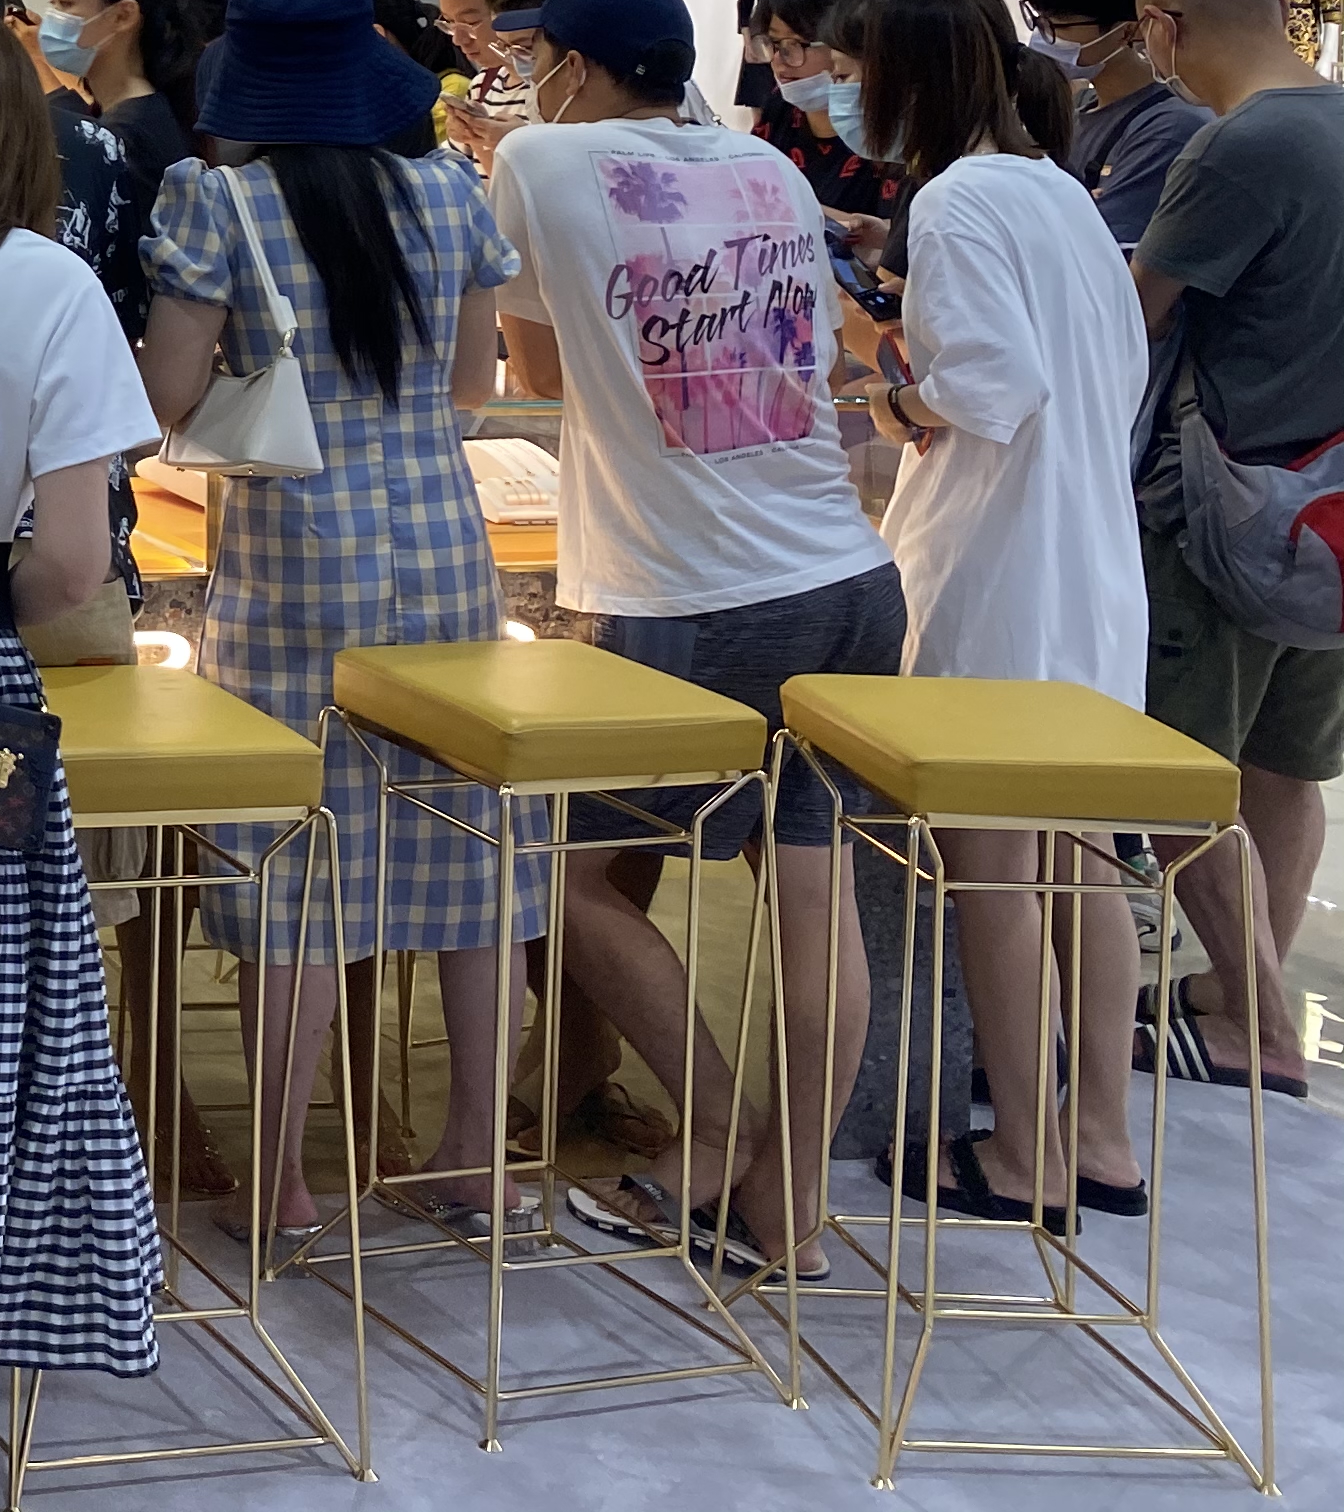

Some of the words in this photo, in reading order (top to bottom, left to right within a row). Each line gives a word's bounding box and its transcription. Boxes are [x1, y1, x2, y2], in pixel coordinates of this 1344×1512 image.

[605, 248, 719, 320] Good
[723, 232, 816, 291] Times
[637, 290, 757, 367] Start
